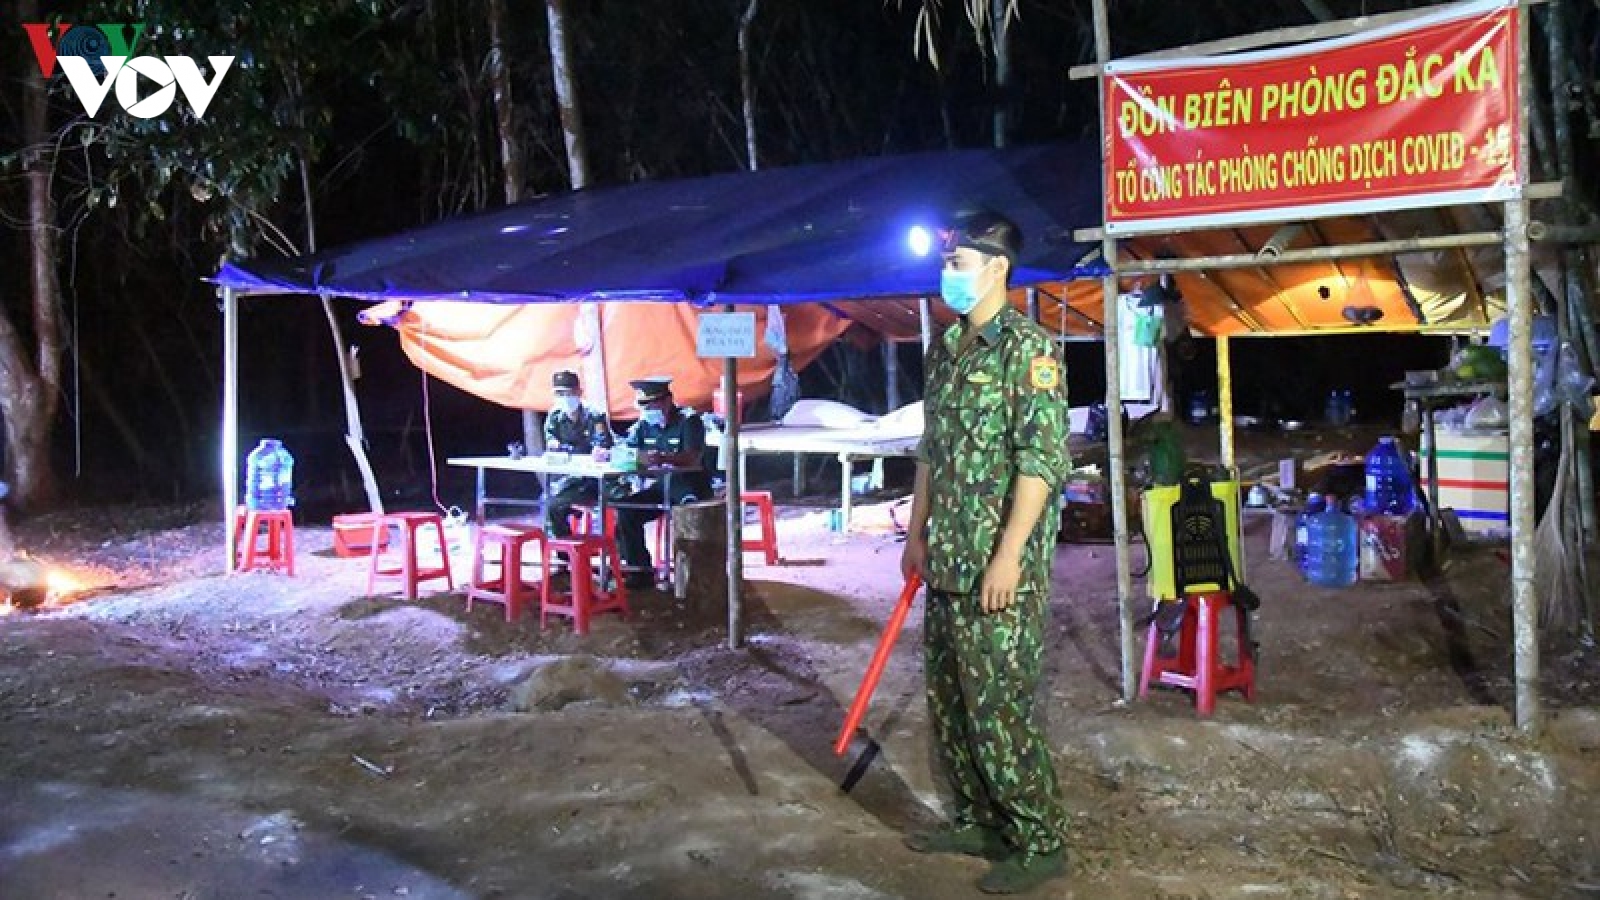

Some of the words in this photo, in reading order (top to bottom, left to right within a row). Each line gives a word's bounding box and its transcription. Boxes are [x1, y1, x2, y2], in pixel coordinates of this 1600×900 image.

[1118, 85, 1175, 138] ĐỒN
[1183, 78, 1253, 130] BIÊN
[1261, 68, 1367, 122] PHÒNG
[1375, 45, 1443, 105] ĐẮC
[1453, 46, 1499, 93] KA
[1141, 155, 1183, 203] CÔNG
[1185, 150, 1216, 197] TÁC
[1219, 144, 1279, 194] PHÒNG
[1282, 135, 1345, 189] CHỐNG
[1351, 138, 1397, 188] DỊCH
[1402, 131, 1464, 175] COVID
